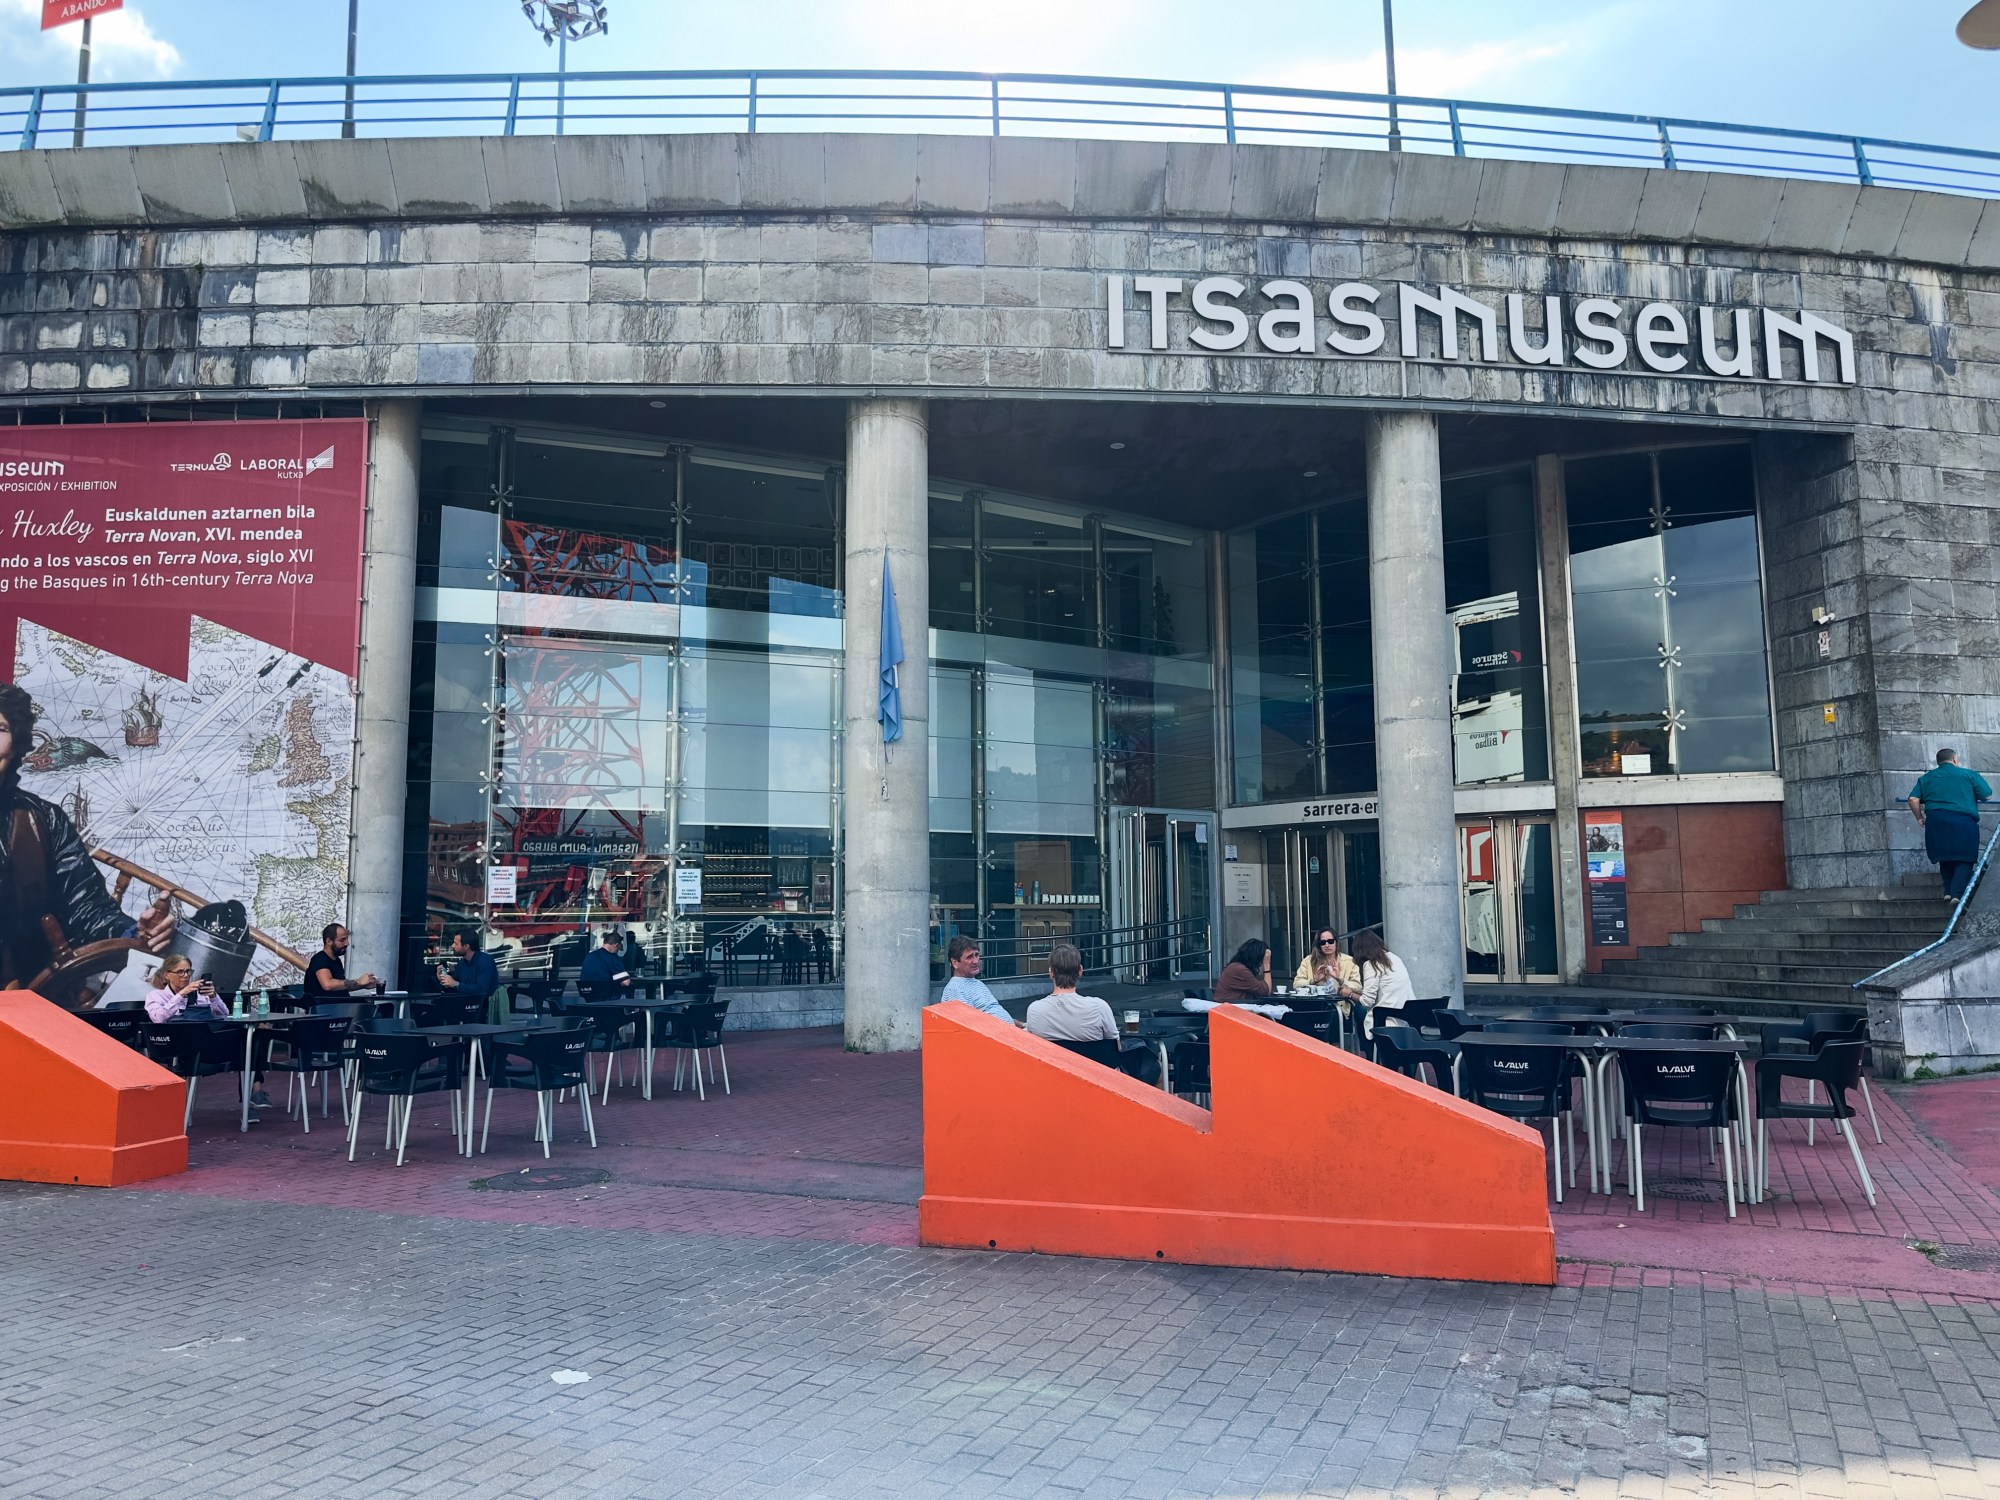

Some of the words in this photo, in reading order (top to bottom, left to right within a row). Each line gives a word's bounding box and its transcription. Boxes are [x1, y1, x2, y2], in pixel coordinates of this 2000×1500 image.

[61, 0, 107, 18] ABANDO
[170, 463, 216, 472] TERNUA
[240, 458, 304, 470] LABORAL
[277, 471, 304, 479] kutxa
[61, 480, 117, 491] EXHIBITION
[105, 508, 207, 522] Euskaldunen
[211, 506, 282, 520] aztarnen
[286, 505, 316, 519] bila
[12, 508, 95, 544] Huxley
[105, 530, 146, 544] Terra
[149, 528, 200, 543] Novan,
[204, 528, 236, 541] XVI.
[240, 526, 303, 541] mendea
[0, 554, 29, 568] ndo
[34, 557, 42, 568] a
[48, 554, 70, 567] los
[75, 556, 128, 566] vascos
[132, 554, 152, 566] en
[158, 552, 196, 564] Terra
[200, 550, 242, 564] Nova,
[246, 550, 284, 566] siglo
[288, 549, 314, 562] XVI
[0, 578, 9, 592] g
[14, 576, 38, 588] the
[42, 575, 108, 591] Basques
[112, 574, 126, 587] in
[132, 572, 230, 588] 16th-century
[235, 572, 272, 584] Terra
[277, 570, 314, 584] Nova
[1669, 1065, 1696, 1073] SALVE
